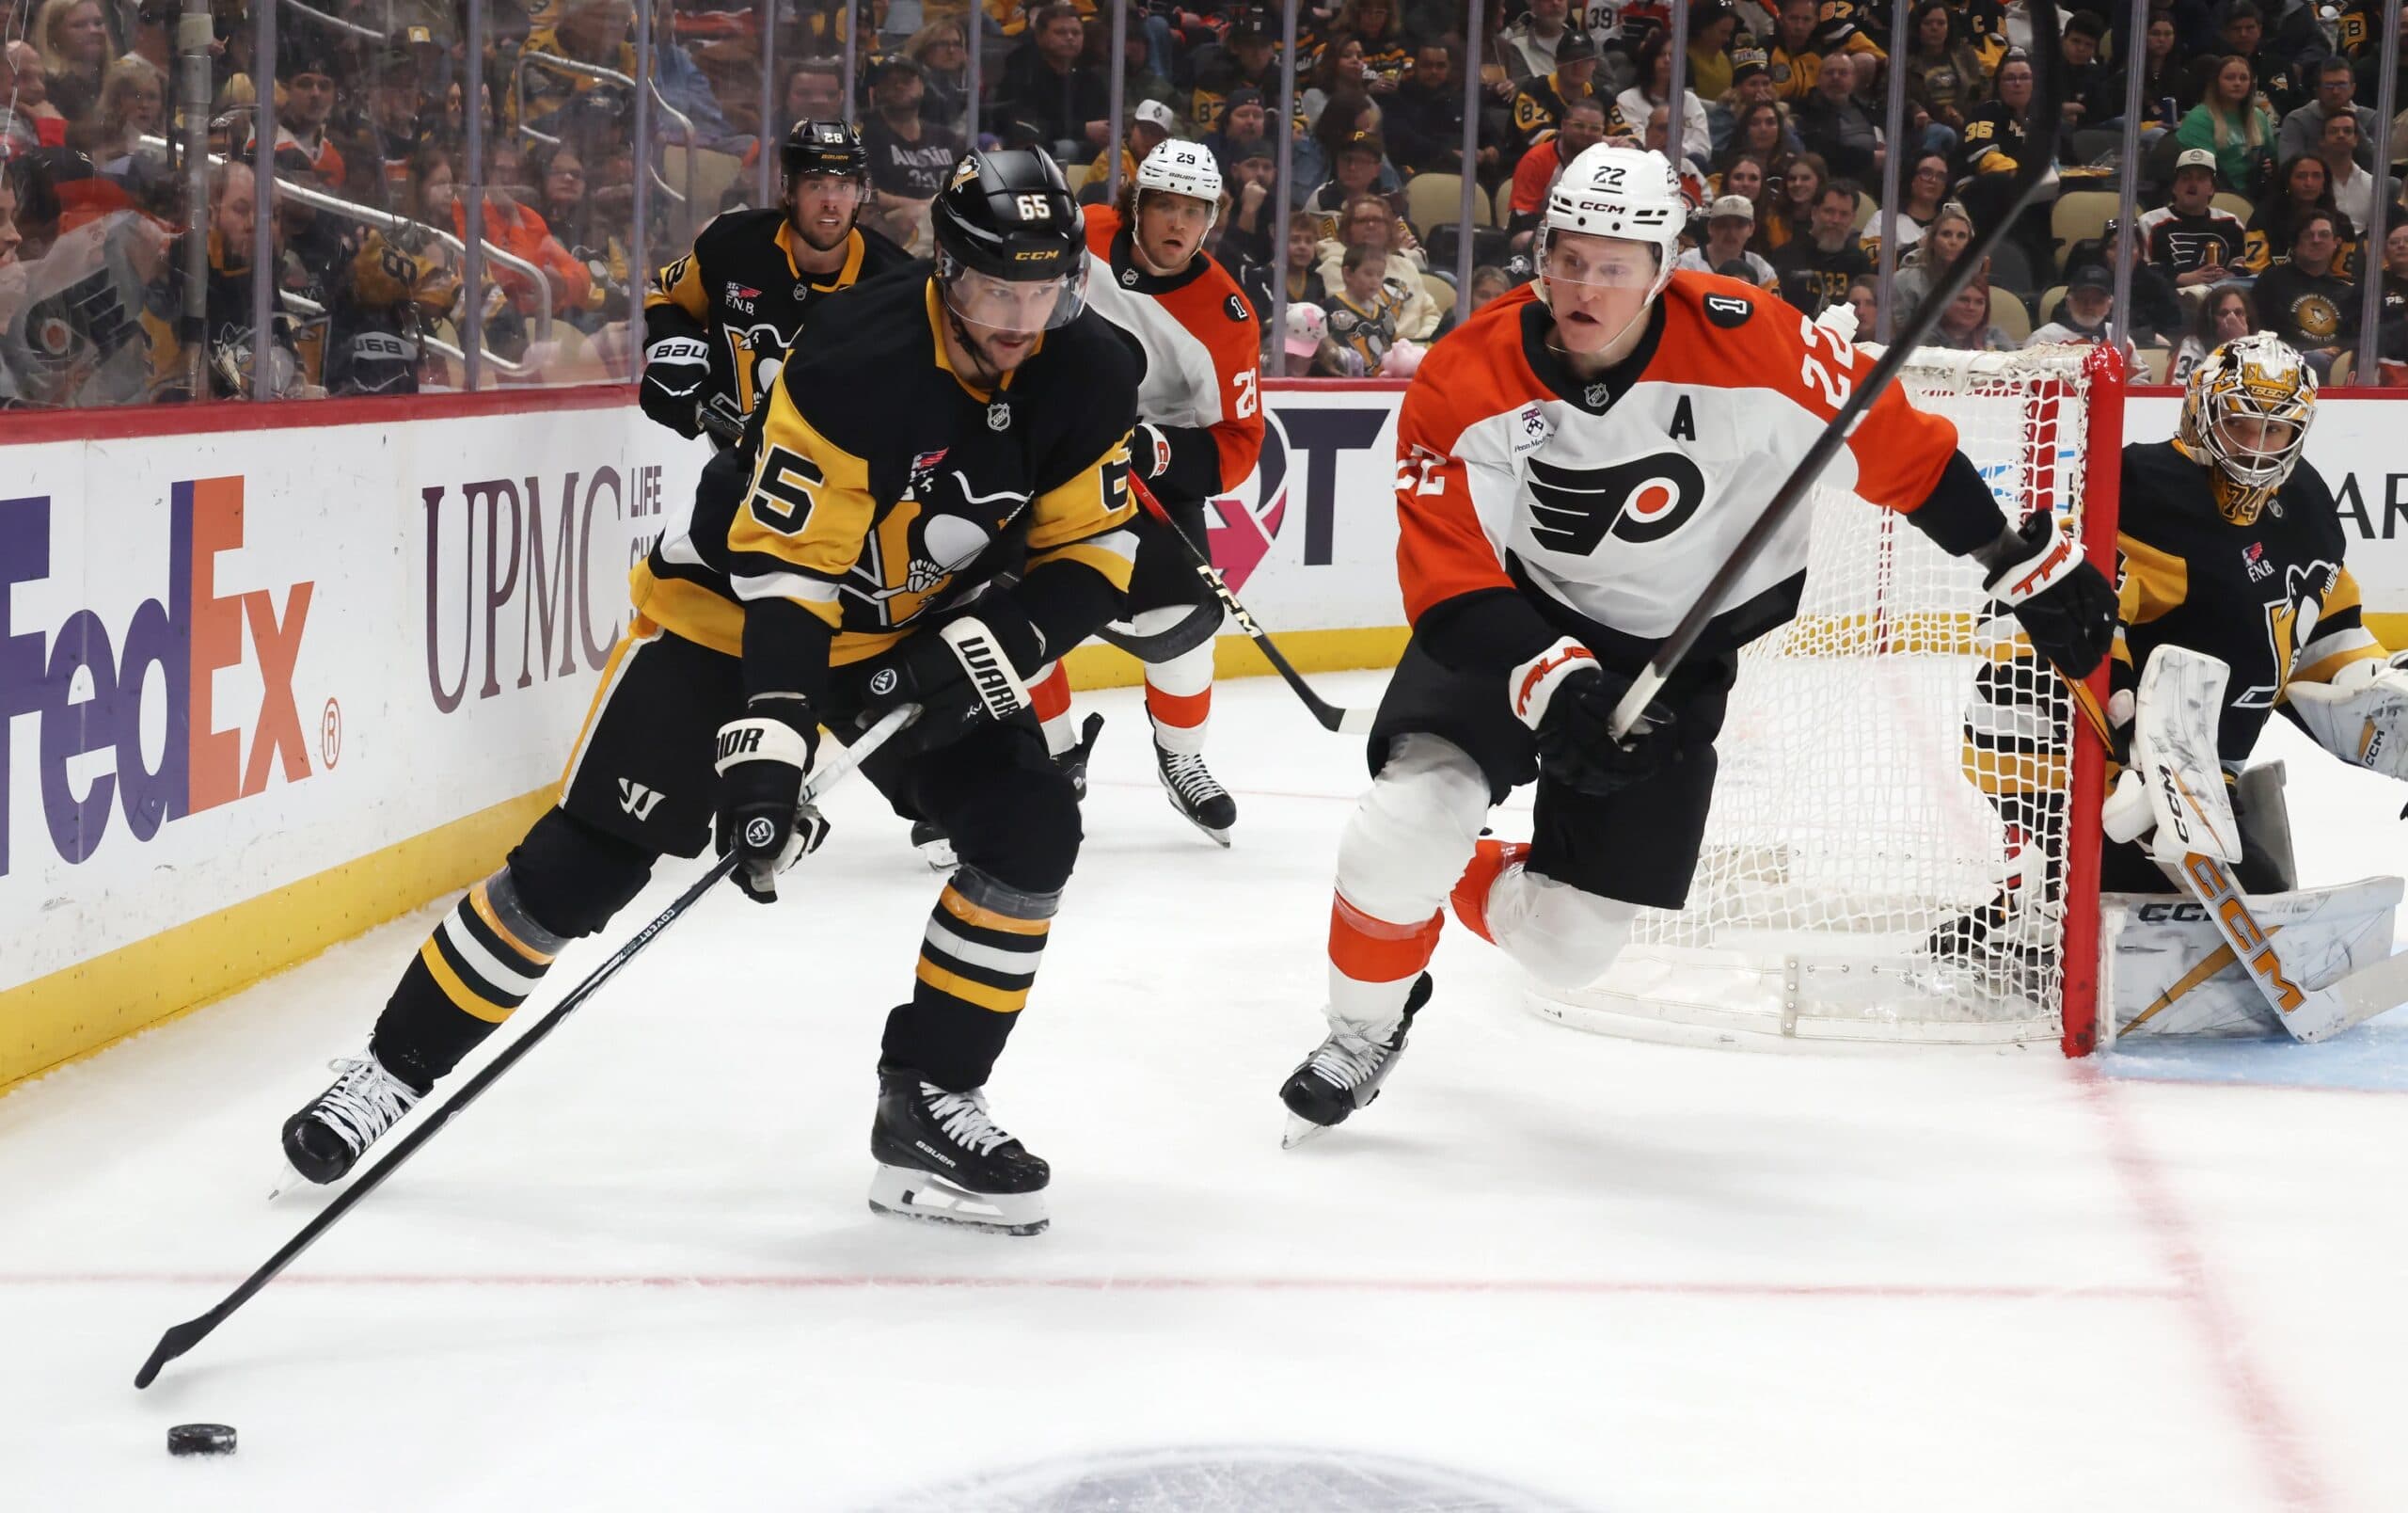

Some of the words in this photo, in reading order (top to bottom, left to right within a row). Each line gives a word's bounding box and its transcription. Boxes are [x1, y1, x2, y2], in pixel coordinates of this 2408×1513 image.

[1590, 8, 1612, 29] 39
[824, 132, 844, 144] 28
[1354, 131, 1365, 141] P
[1176, 152, 1196, 165] 29
[1593, 166, 1626, 186] 22
[1017, 194, 1052, 221] 65
[1579, 200, 1626, 215] CCM
[1015, 249, 1059, 262] CCM
[1231, 295, 1248, 319] 1
[1708, 296, 1748, 314] 1
[1799, 314, 1855, 410] 22
[2251, 385, 2289, 399] CCM
[1668, 394, 1697, 442] A
[630, 465, 662, 518] LIFE
[2222, 481, 2271, 522] 74
[422, 465, 622, 715] UPMC
[2365, 729, 2385, 767] CCM
[2159, 764, 2190, 844] CCM
[2138, 902, 2214, 922] CC
[639, 908, 675, 942] COVERT
[2183, 851, 2307, 1016] CCM
